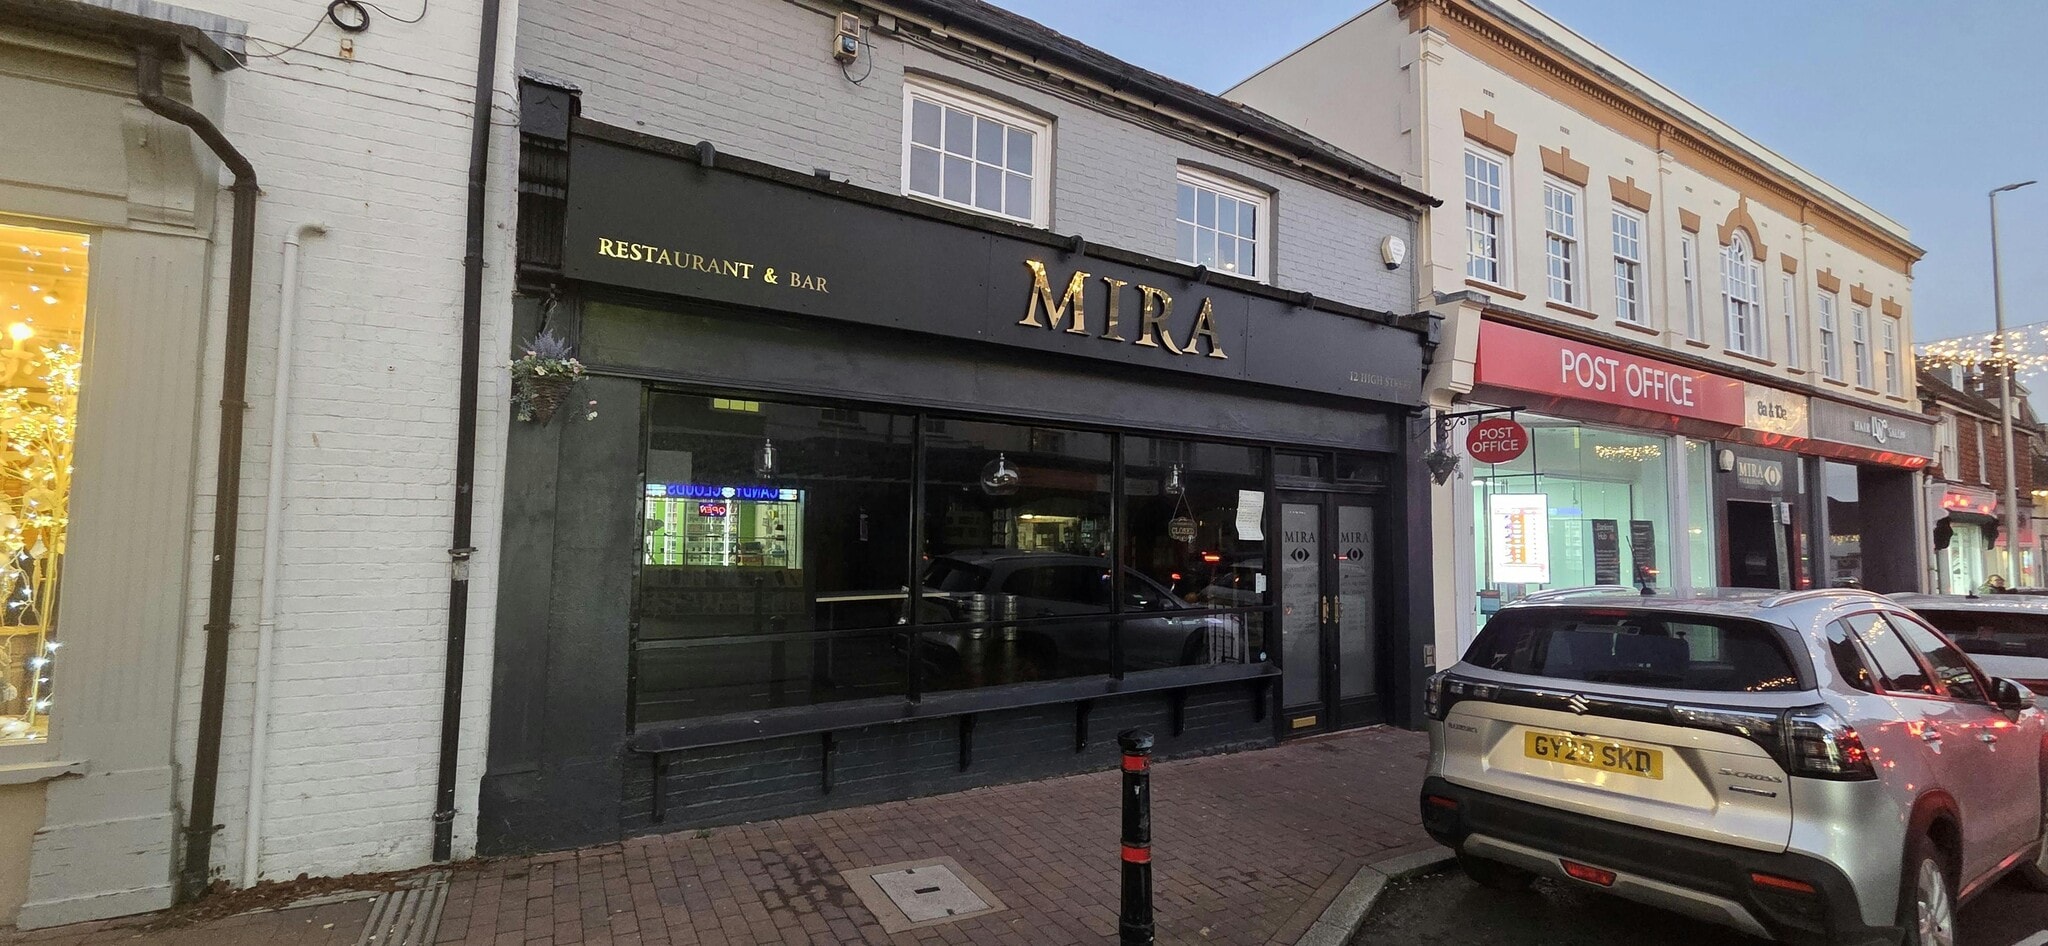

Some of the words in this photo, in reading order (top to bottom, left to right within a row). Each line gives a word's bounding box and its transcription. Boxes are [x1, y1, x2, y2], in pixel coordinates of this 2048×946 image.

[598, 236, 755, 280] RESTAURANT
[764, 266, 778, 285] &
[789, 271, 830, 294] BAR
[1018, 258, 1229, 360] MIRA
[1349, 370, 1359, 382] 12
[1360, 372, 1383, 386] HIGH
[1561, 348, 1620, 393] POST
[1625, 363, 1694, 407] OFFICE
[1479, 426, 1514, 440] POST
[1854, 420, 1871, 433] HAIR
[1471, 438, 1519, 454] OFFICE
[1738, 461, 1764, 479] MIRA
[1284, 531, 1316, 544] MIRA
[1340, 532, 1370, 544] MIRA
[1601, 745, 1651, 773] SKD
[1717, 766, 1783, 784] S-CROSS
